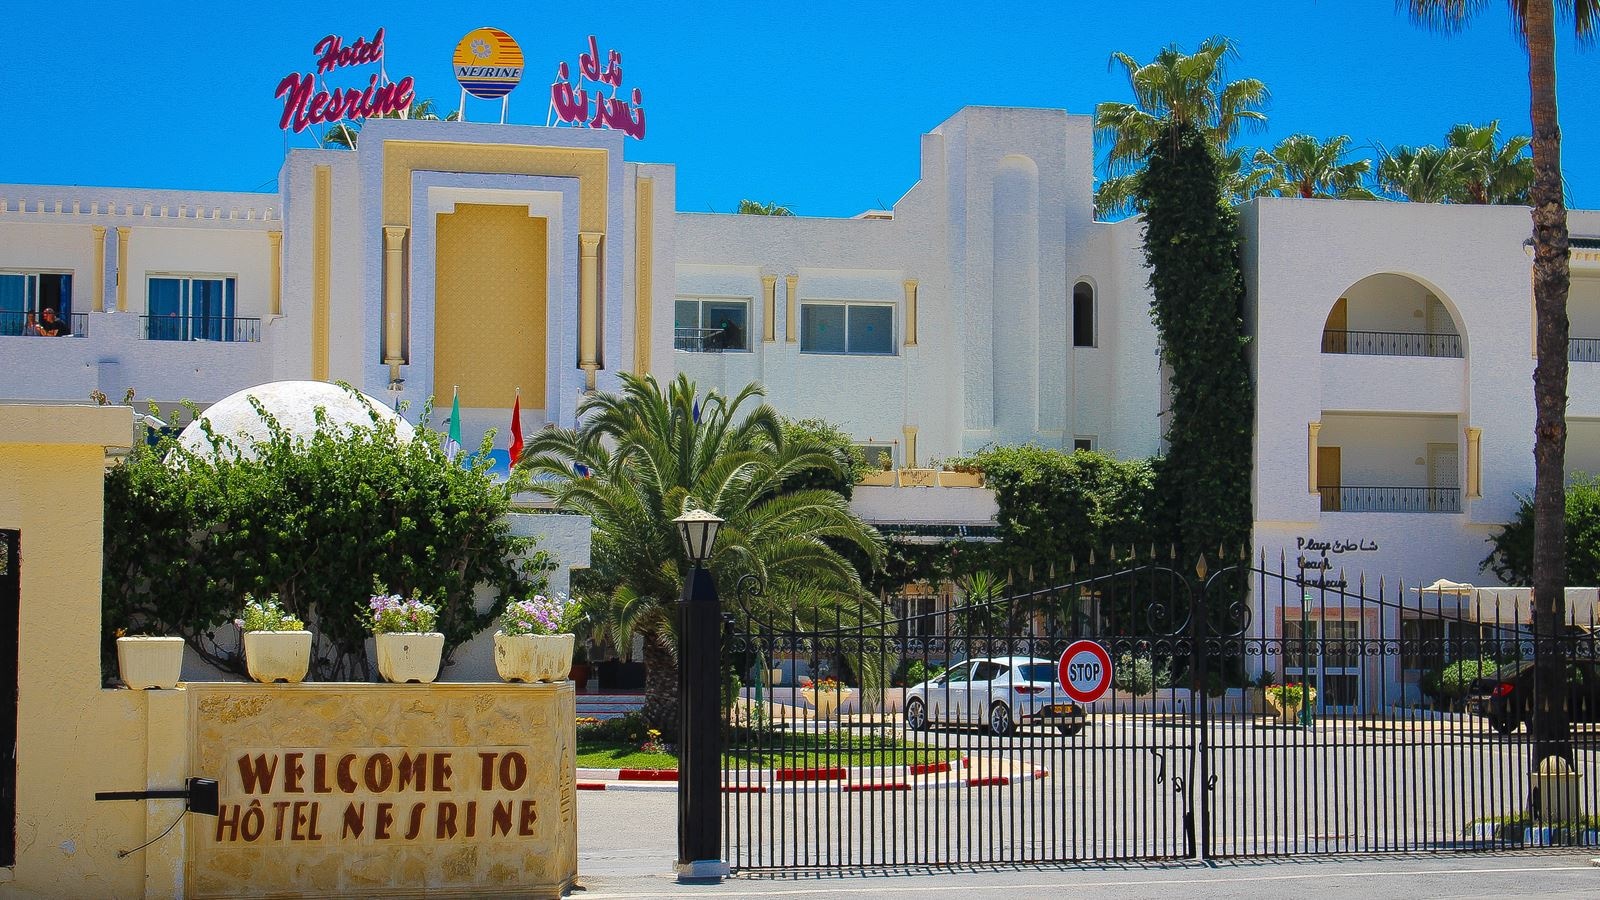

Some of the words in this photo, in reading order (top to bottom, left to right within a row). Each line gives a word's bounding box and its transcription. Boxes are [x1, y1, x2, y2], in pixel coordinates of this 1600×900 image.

[313, 27, 385, 75] Hotel
[458, 66, 521, 78] NESRINE
[274, 72, 415, 133] Nesrine
[1296, 536, 1331, 557] Plage
[1296, 574, 1348, 588] Barecue
[1070, 663, 1100, 682] STOP
[237, 751, 454, 795] WELCOME
[479, 751, 528, 792] TO
[215, 798, 322, 842] HÔTEL
[342, 800, 537, 840] NESRINE
